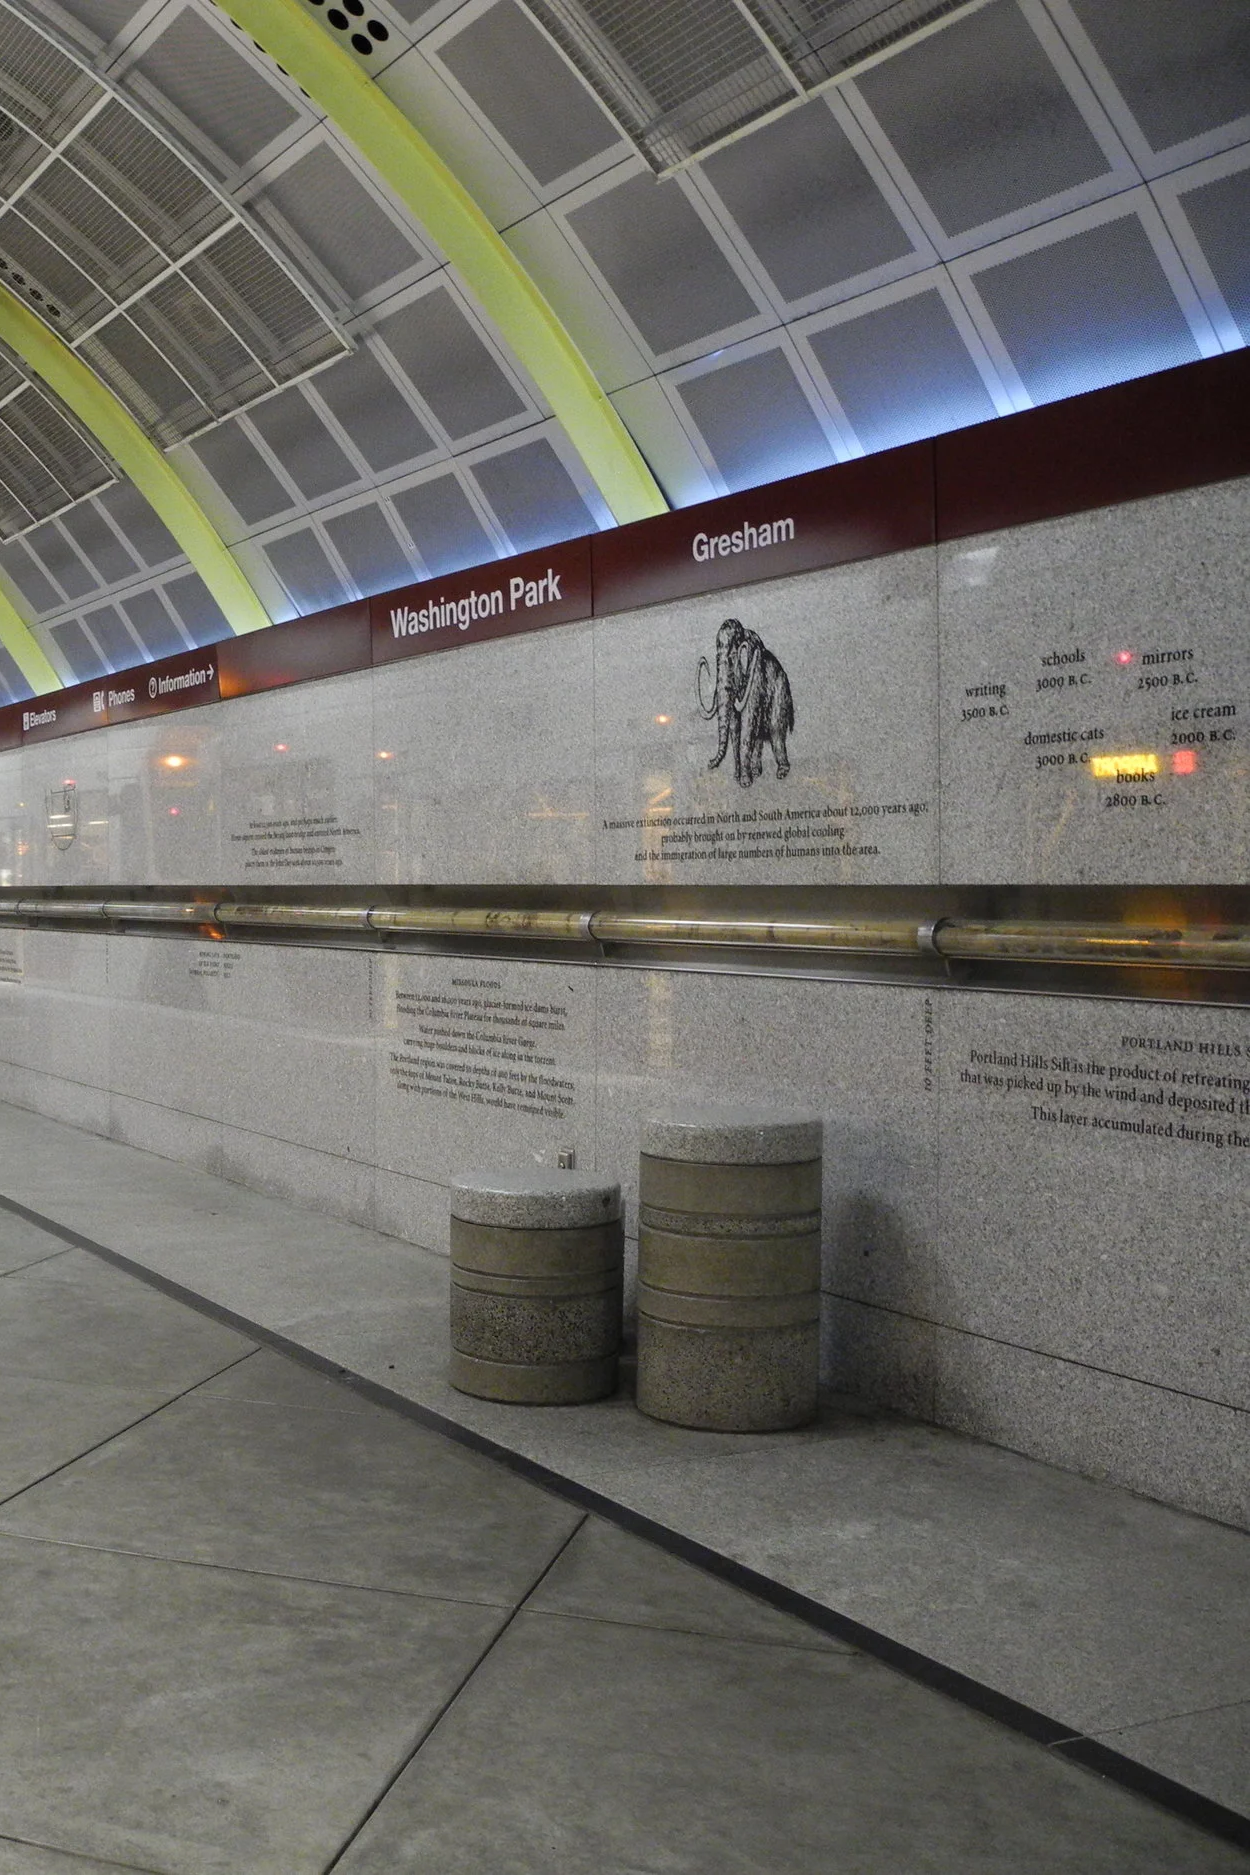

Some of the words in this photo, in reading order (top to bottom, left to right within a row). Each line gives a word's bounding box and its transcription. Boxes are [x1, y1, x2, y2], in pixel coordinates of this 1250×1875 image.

[692, 517, 795, 562] Gresham
[390, 591, 504, 638] Washington
[510, 568, 562, 611] Park
[1041, 648, 1086, 667] schools
[1142, 649, 1194, 666] mirrors
[158, 668, 207, 695] Information
[965, 683, 1006, 698] writing
[1035, 675, 1064, 692] 3000
[1137, 675, 1168, 690] 2500
[108, 688, 135, 707] Phones
[30, 708, 57, 727] Elevators
[961, 708, 985, 722] 3500
[1171, 706, 1189, 721] ice
[1193, 704, 1237, 719] cream
[1024, 730, 1077, 746] domestic
[1080, 728, 1104, 742] cats
[1171, 732, 1204, 745] 2000
[1035, 754, 1064, 769] 3000
[1116, 768, 1155, 784] books
[1105, 795, 1137, 808] 2800
[636, 815, 672, 828] extinction
[673, 814, 706, 826] occurred
[707, 813, 715, 824] in
[716, 811, 740, 824] North
[742, 809, 757, 822] and
[758, 808, 782, 821] South
[784, 807, 821, 820] America
[822, 805, 848, 818] about
[850, 805, 880, 818] 12,000
[881, 804, 906, 818] years
[661, 832, 692, 847] probably
[694, 829, 723, 845] brought
[725, 831, 735, 841] on
[737, 829, 748, 844] by
[748, 826, 782, 841] renewed
[784, 825, 810, 841] global
[811, 824, 845, 840] cooling
[634, 850, 647, 861] and
[648, 849, 659, 861] the
[661, 850, 707, 862] immigration
[708, 848, 717, 860] of
[718, 848, 737, 862] large
[739, 847, 774, 859] numbers
[775, 845, 784, 860] of
[786, 845, 820, 858] humans
[822, 846, 840, 857] into
[842, 842, 857, 856] the
[859, 845, 880, 855] area.
[1121, 1035, 1193, 1053] PORTLAND
[1199, 1042, 1241, 1057] HILLS
[970, 1050, 1018, 1068] Portland
[1021, 1054, 1049, 1071] Hills
[1051, 1057, 1070, 1072] Silt
[1073, 1058, 1084, 1074] is
[1086, 1058, 1105, 1076] the
[1109, 1064, 1160, 1082] product
[1163, 1067, 1179, 1084] of
[1181, 1070, 1250, 1095] retreating
[960, 1069, 982, 1085] that
[984, 1074, 1004, 1088] was
[1007, 1075, 1043, 1093] picked
[1047, 1081, 1062, 1098] up
[1064, 1079, 1080, 1098] by
[1082, 1081, 1101, 1098] the
[1105, 1085, 1137, 1103] wind
[1139, 1088, 1165, 1106] and
[1167, 1091, 1235, 1114] deposited
[1031, 1105, 1057, 1123] This
[1059, 1107, 1088, 1128] layer
[1091, 1113, 1173, 1138] accumulated
[1176, 1123, 1224, 1148] during
